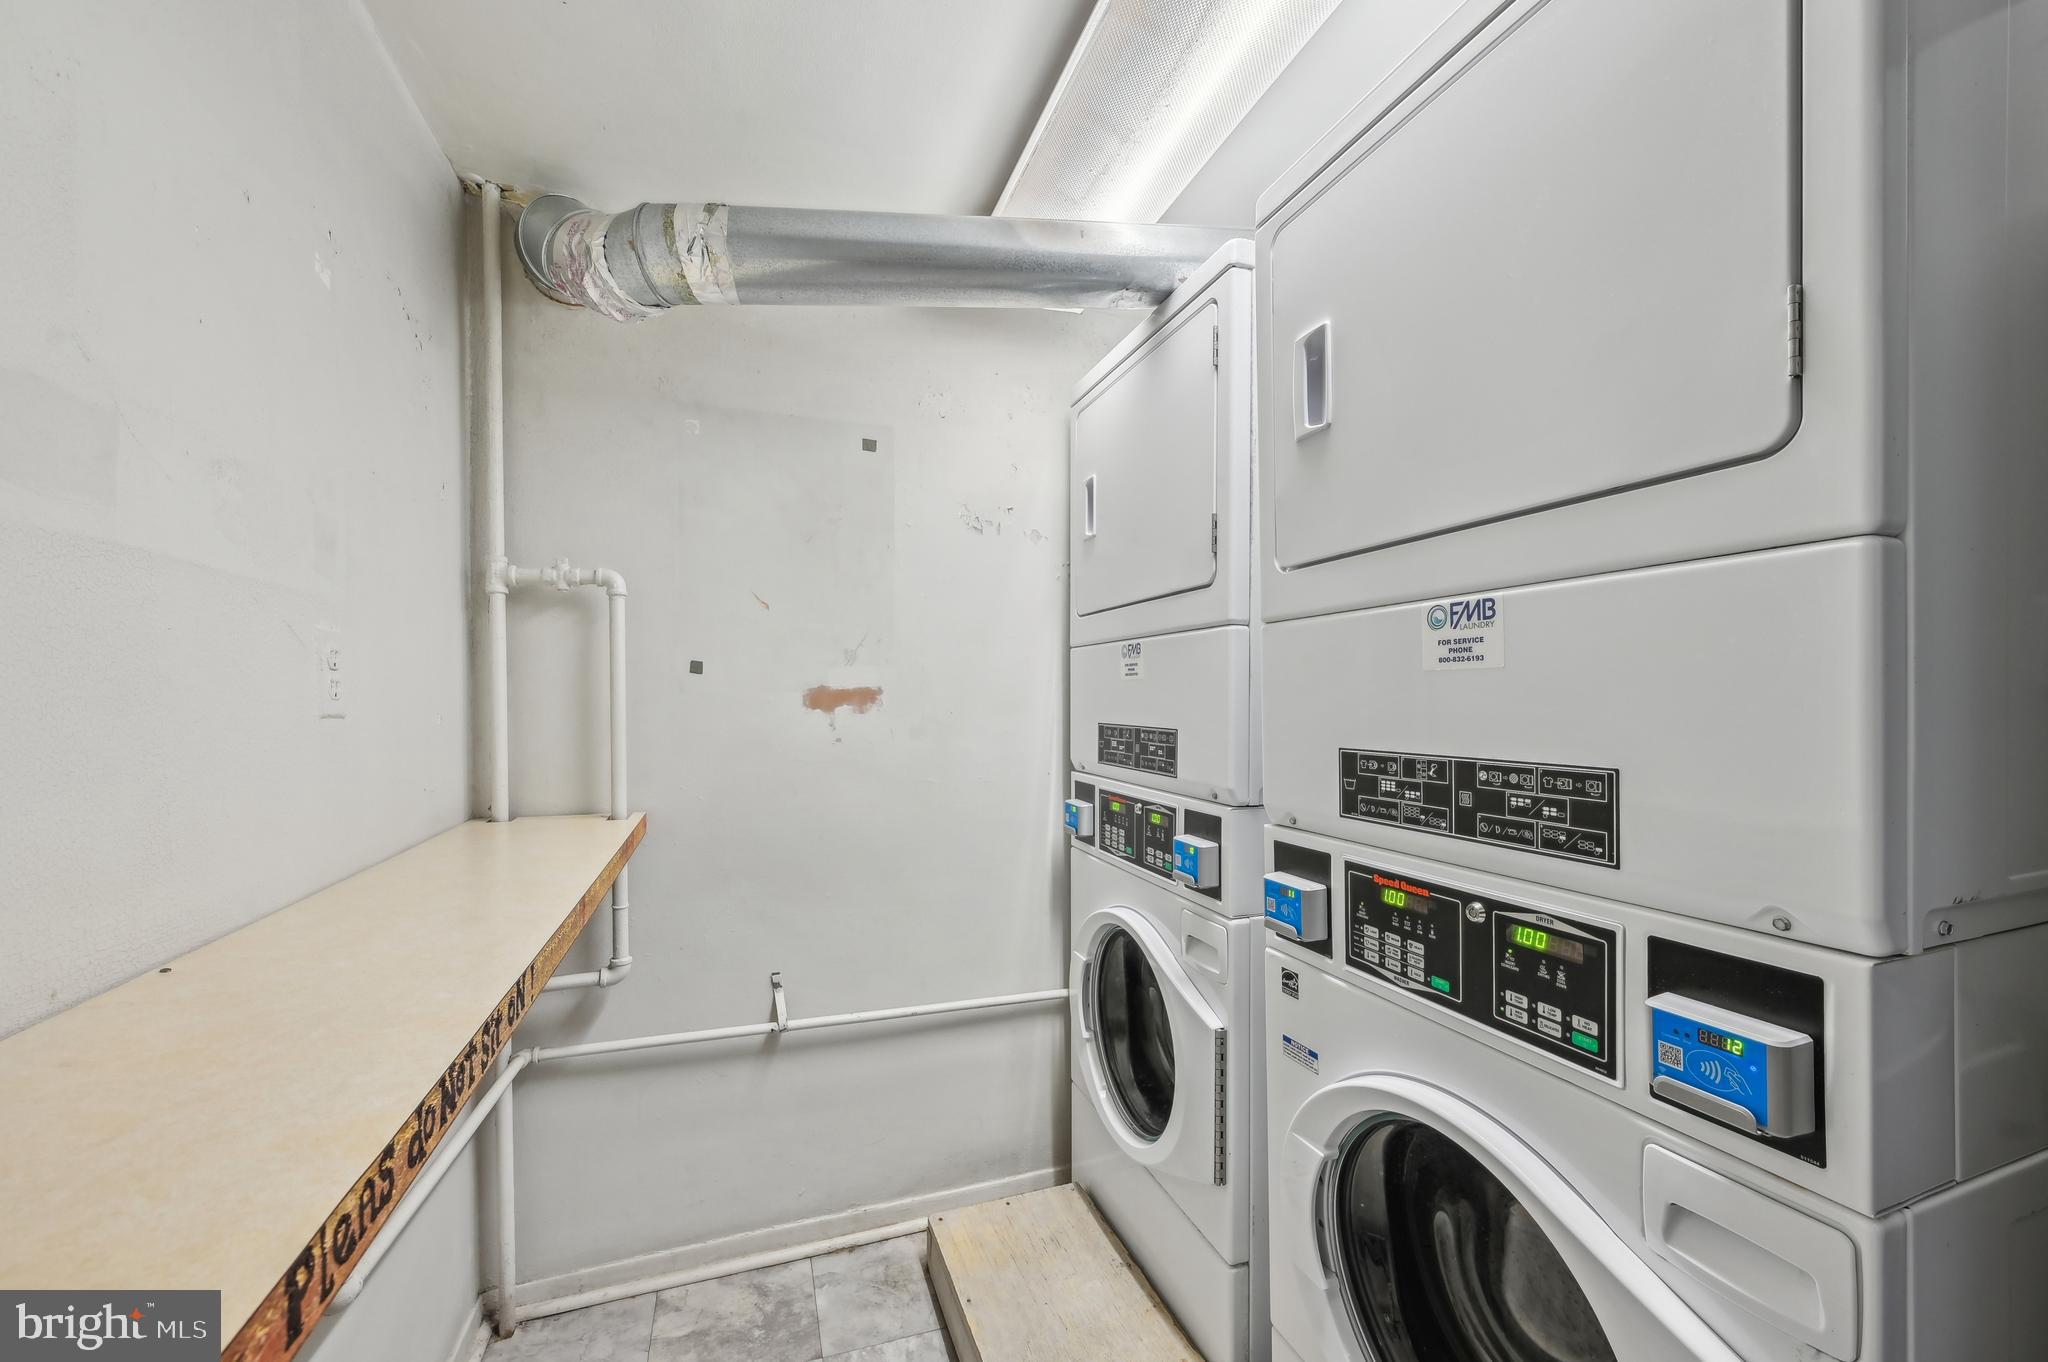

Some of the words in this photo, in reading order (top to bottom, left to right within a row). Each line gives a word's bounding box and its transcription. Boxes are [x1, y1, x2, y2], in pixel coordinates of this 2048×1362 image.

[1450, 597, 1496, 630] FMB
[1460, 620, 1495, 631] LAUNDRY
[1453, 636, 1485, 645] SERVICE
[1127, 642, 1141, 659] FMB
[1448, 646, 1473, 654] PHONE
[1438, 654, 1485, 664] 800-832-6193
[1373, 874, 1399, 889] Speed
[1400, 881, 1430, 897] Queen
[1535, 915, 1554, 926] DRYER
[1517, 926, 1546, 949] 1.00
[1727, 1038, 1743, 1055] 12
